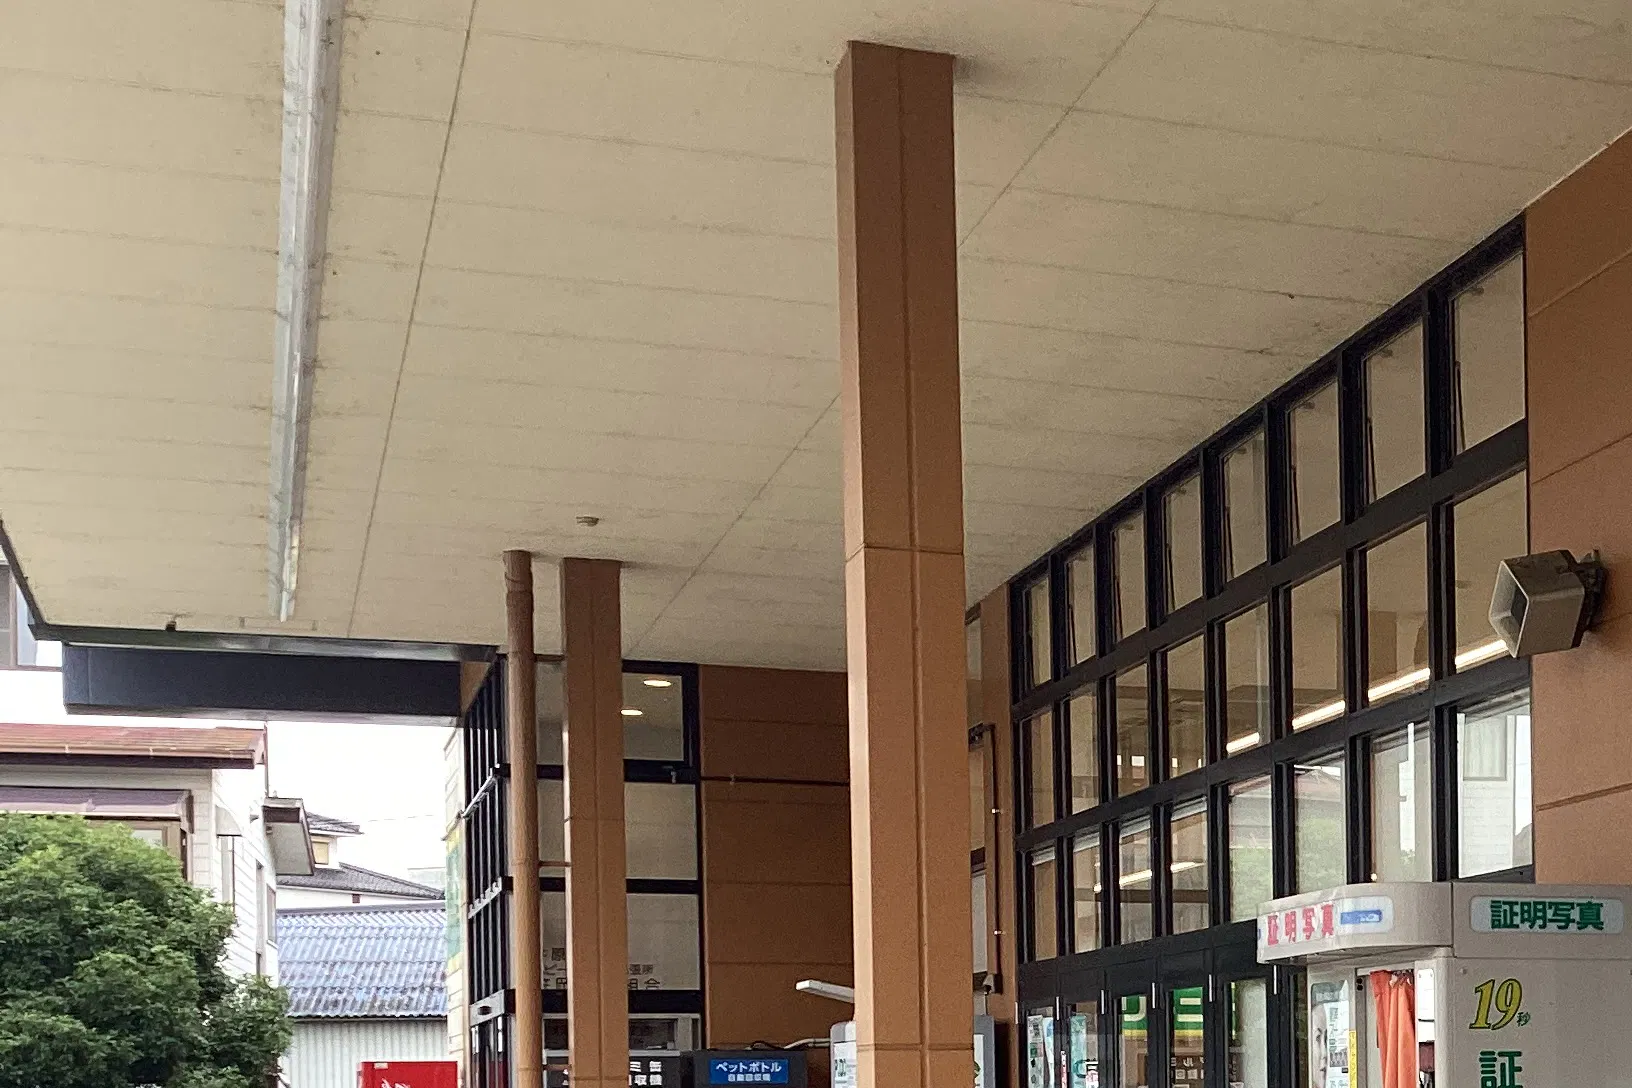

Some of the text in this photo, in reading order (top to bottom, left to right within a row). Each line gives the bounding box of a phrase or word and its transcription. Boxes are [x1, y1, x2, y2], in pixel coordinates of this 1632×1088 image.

[1489, 899, 1605, 931] 証明写真
[715, 1061, 782, 1073] ペットボトル
